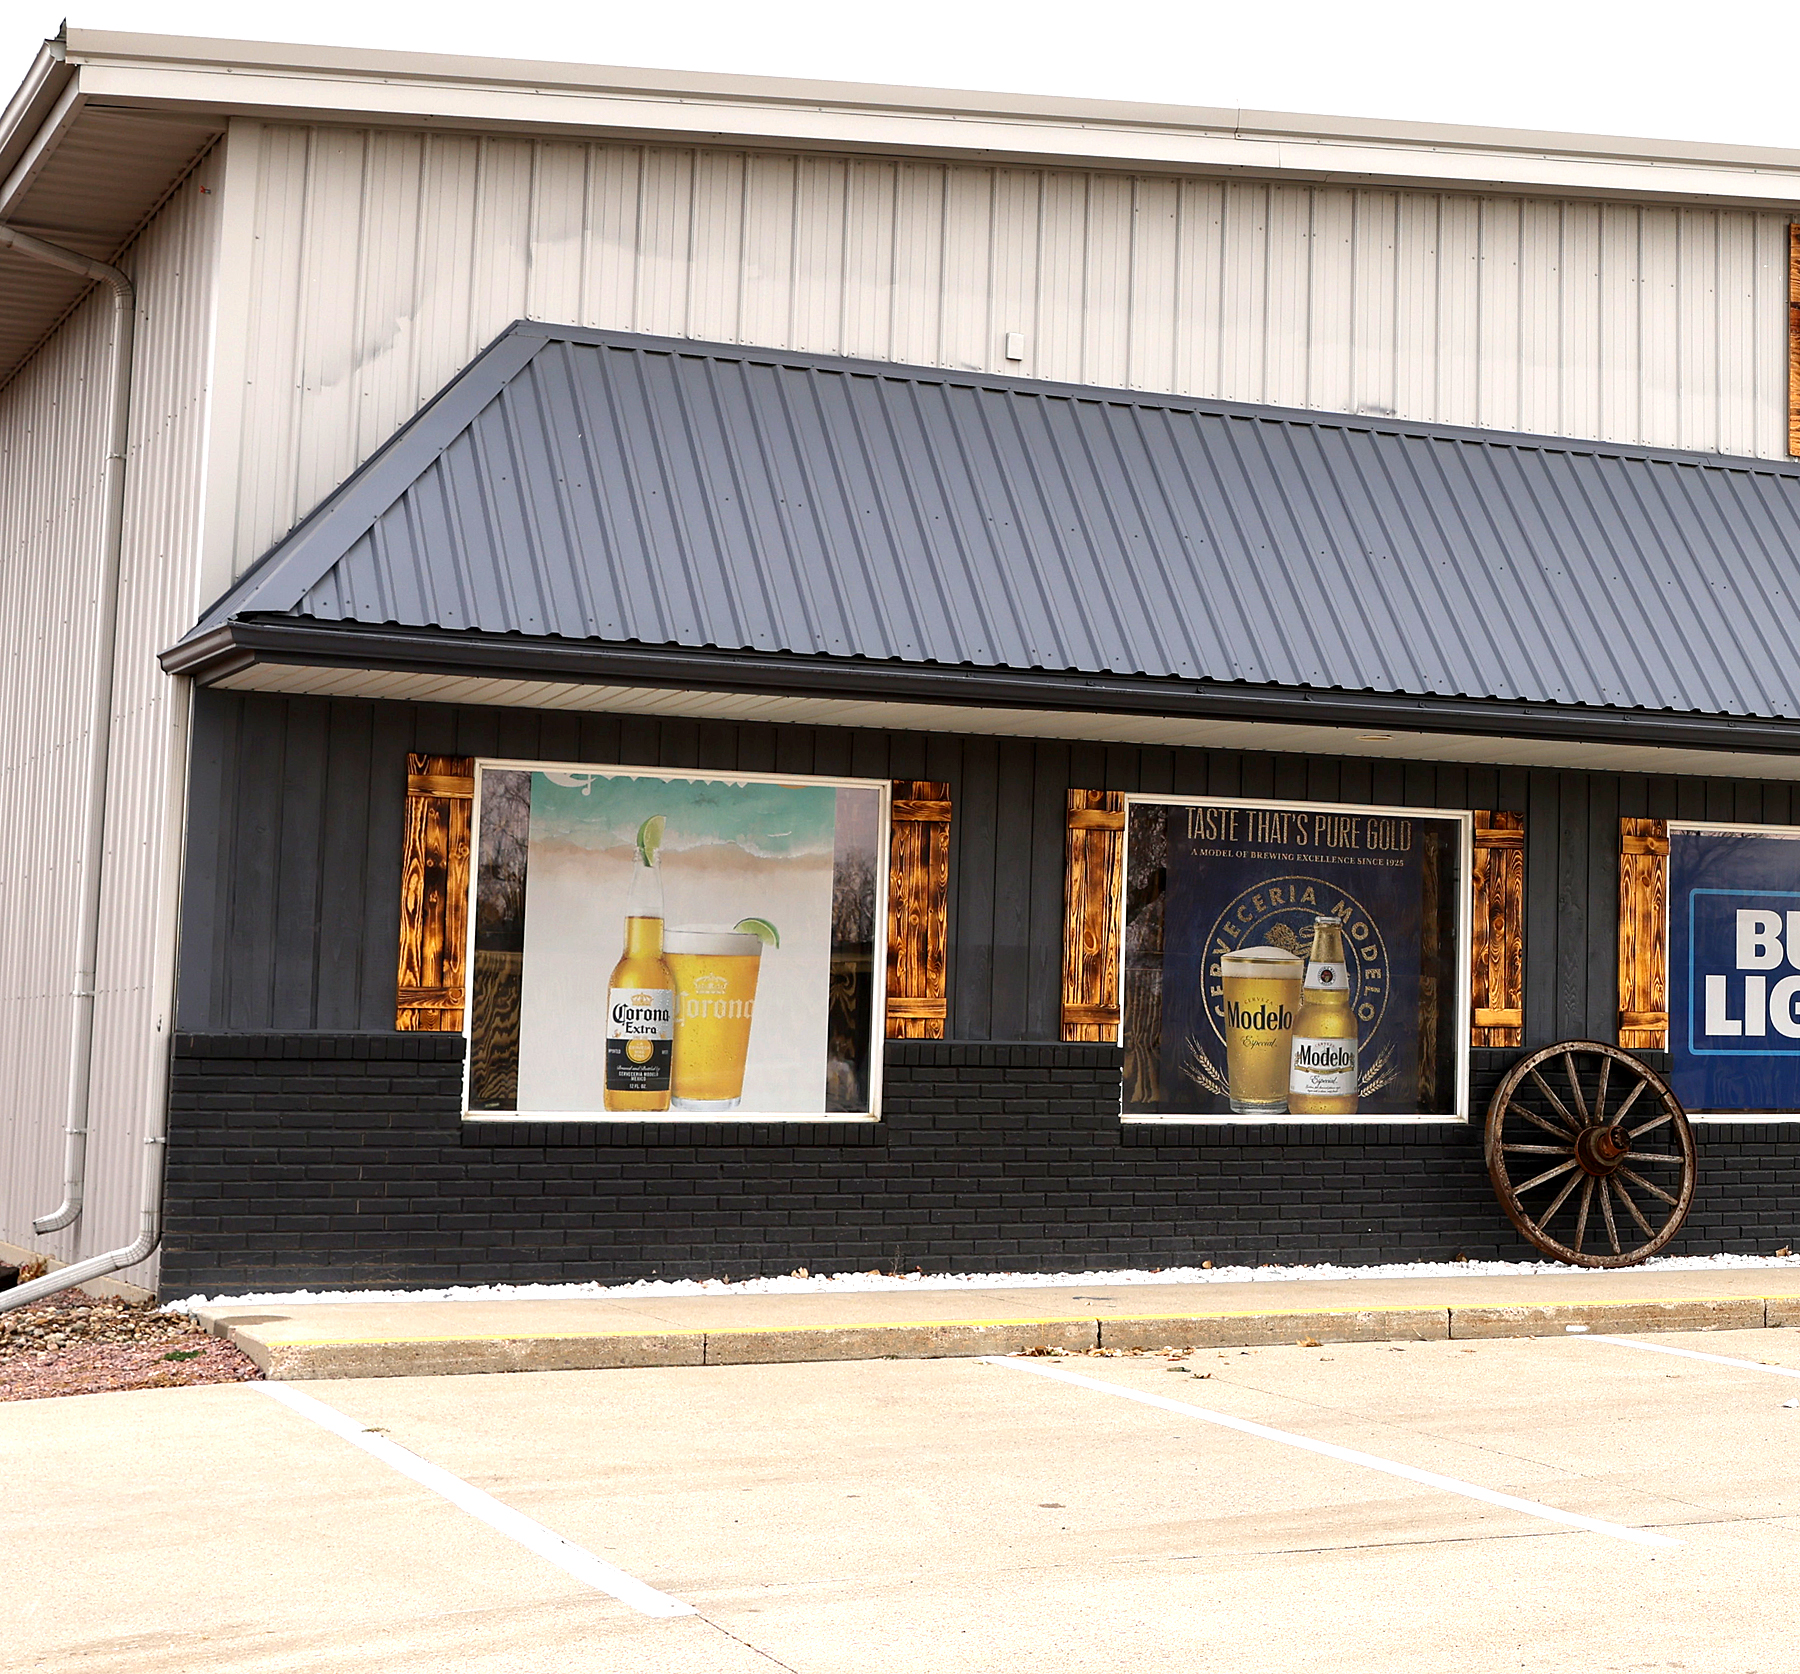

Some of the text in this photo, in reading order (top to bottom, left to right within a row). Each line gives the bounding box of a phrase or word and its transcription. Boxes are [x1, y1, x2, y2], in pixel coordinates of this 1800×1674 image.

[1185, 807, 1412, 851] TASTE THAT'S PURE GOLD
[1190, 848, 1198, 856] A
[1200, 848, 1234, 858] MODEL
[1235, 850, 1249, 859] OF
[1250, 851, 1294, 861] BREWING
[1296, 854, 1356, 865] EXCELLENCE
[1357, 857, 1384, 866] SINCE
[1330, 899, 1383, 1022] MODELO
[612, 1003, 670, 1026] Corona
[1227, 1000, 1293, 1031] Modelo
[625, 1022, 657, 1035] Extra
[1240, 1035, 1276, 1050] Especial
[1300, 1044, 1350, 1067] Modelo
